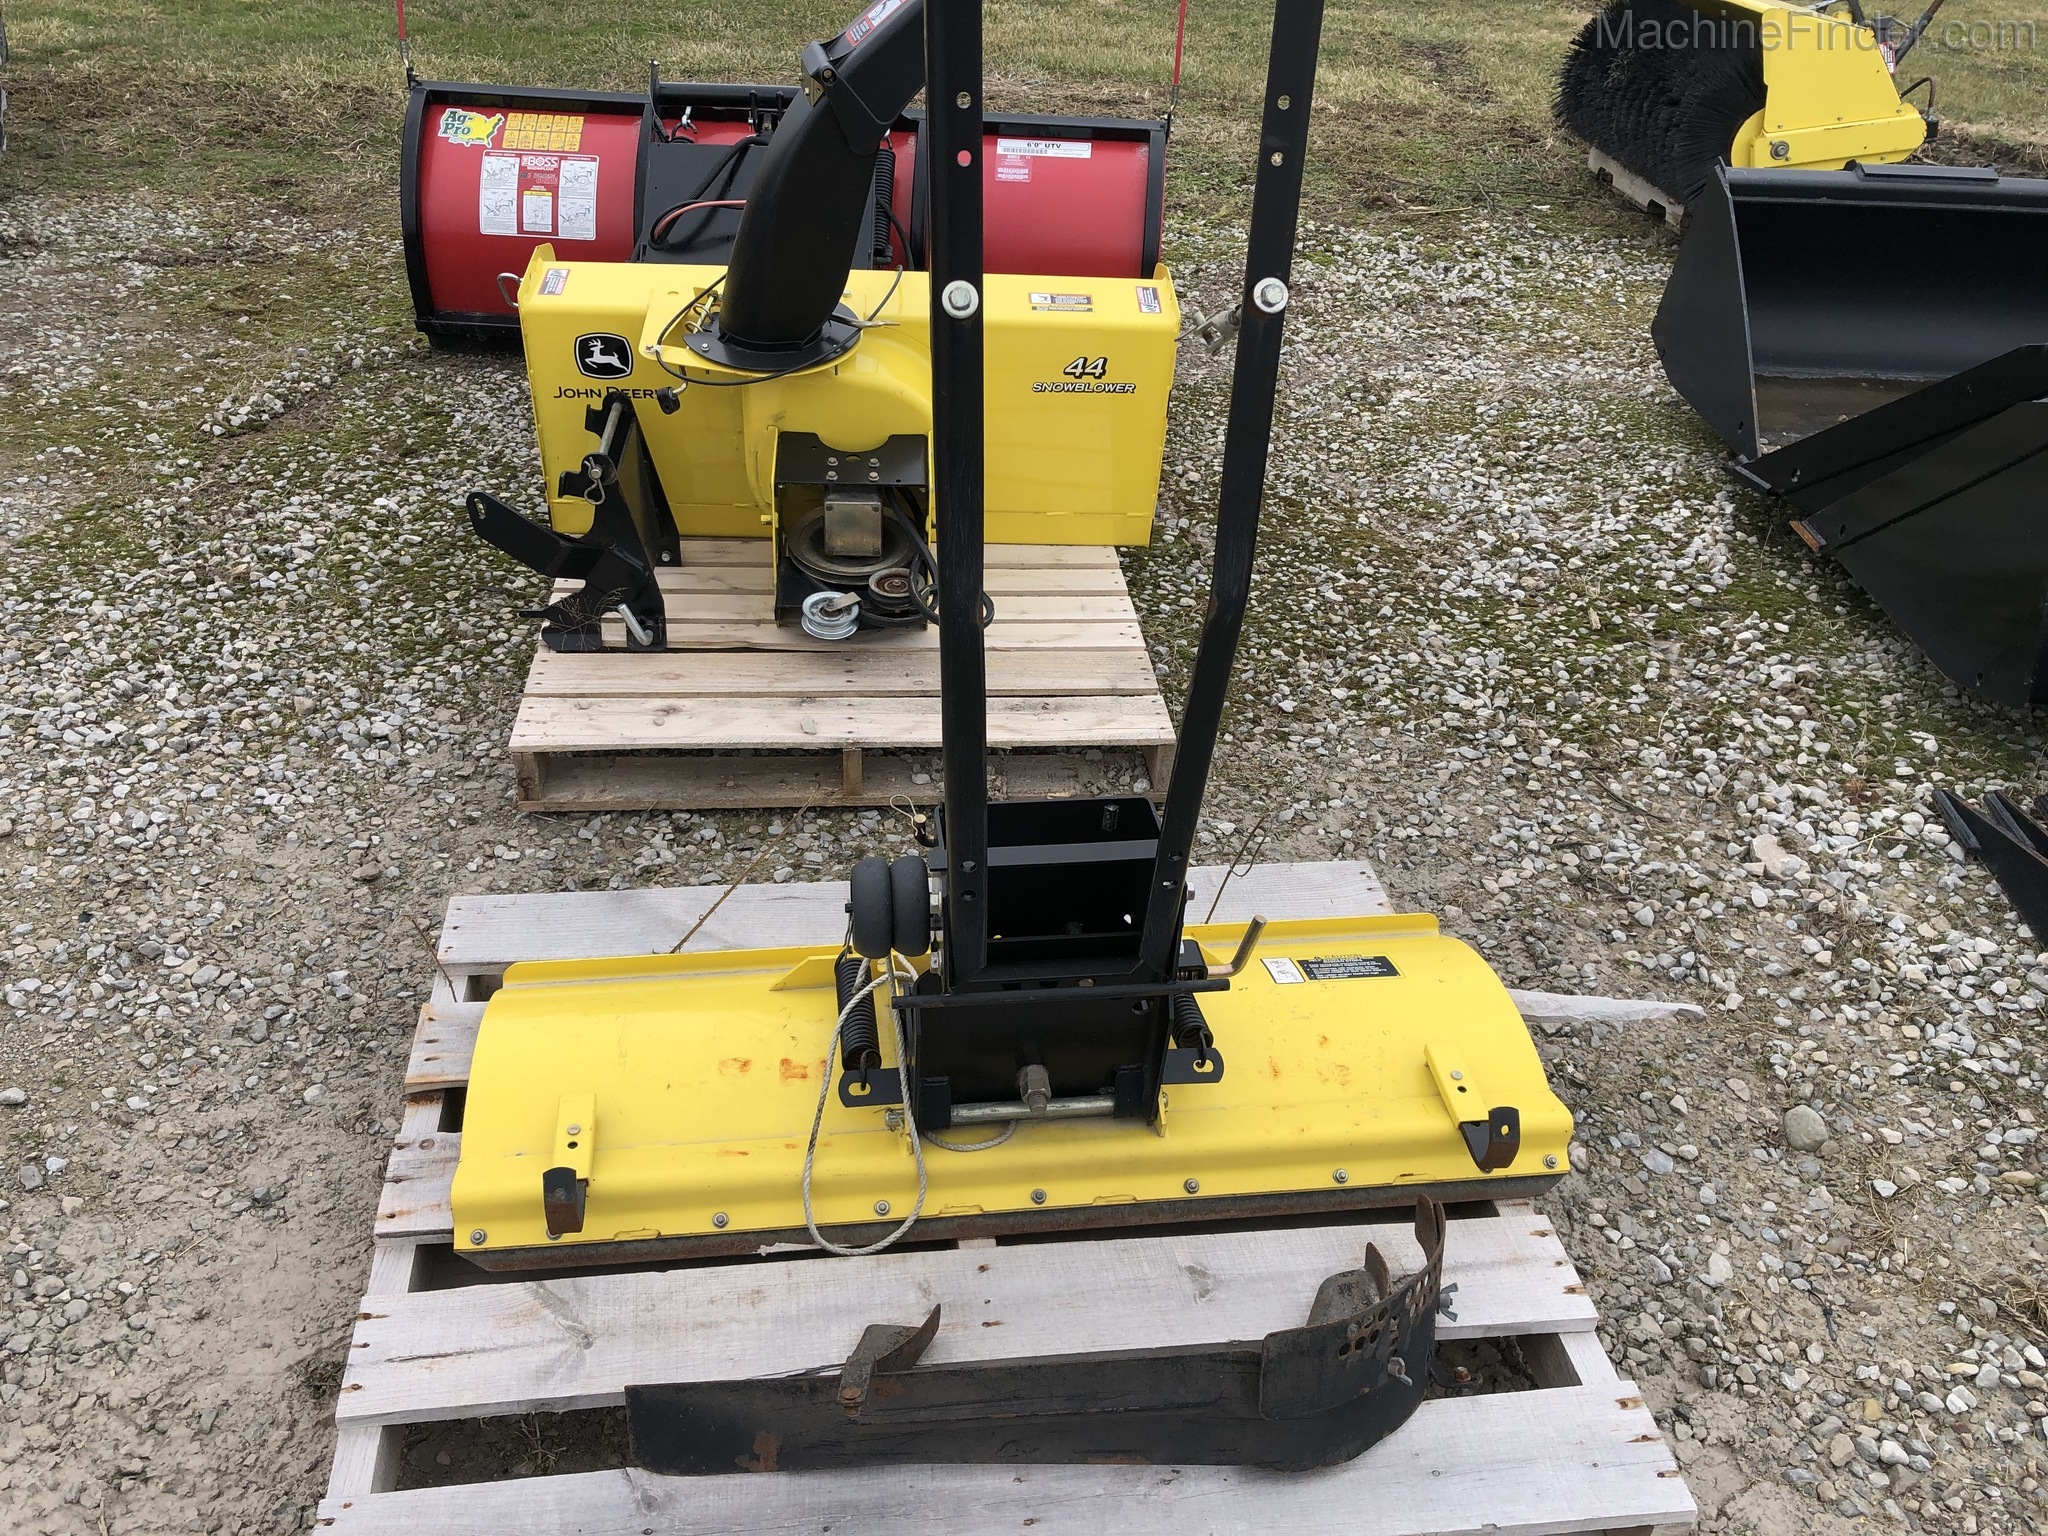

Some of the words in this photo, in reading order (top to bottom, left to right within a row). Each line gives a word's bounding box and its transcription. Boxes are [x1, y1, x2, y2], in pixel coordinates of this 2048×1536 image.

[444, 111, 473, 125] Ag-
[442, 123, 471, 135] Pro
[528, 156, 558, 167] BOSS
[1063, 356, 1109, 380] 44
[553, 386, 602, 399] JOHN
[605, 386, 658, 400] DEER
[1031, 381, 1137, 395] SNOWBLOWER
